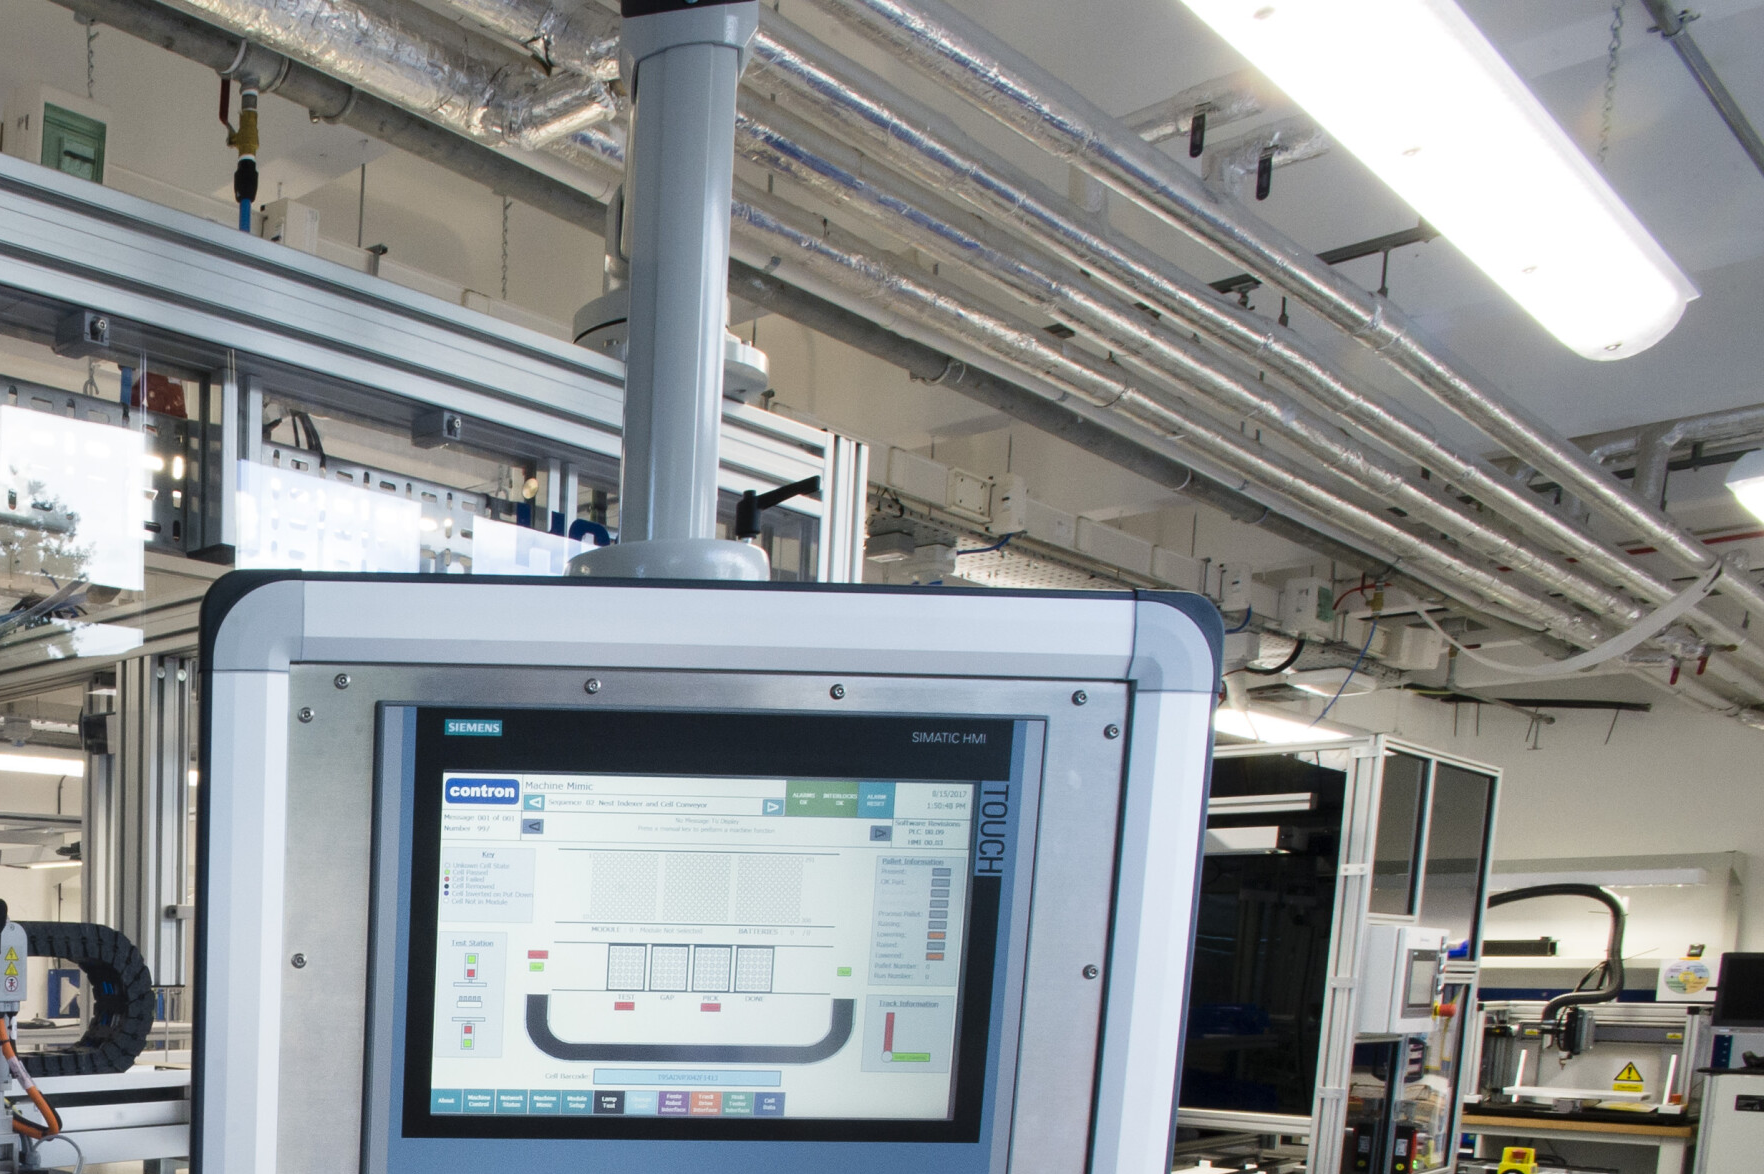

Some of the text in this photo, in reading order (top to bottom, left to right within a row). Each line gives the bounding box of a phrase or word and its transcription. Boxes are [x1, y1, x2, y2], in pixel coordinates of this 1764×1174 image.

[448, 722, 500, 733] SIEMENS
[912, 731, 986, 744] SIMATIC HMI
[449, 784, 515, 798] contron
[525, 781, 594, 791] Machine Mimic
[444, 814, 474, 822] Message
[928, 820, 961, 828] Revisions
[977, 784, 1009, 874] TOUCH
[904, 858, 944, 866] Information
[900, 1000, 939, 1008] Information
